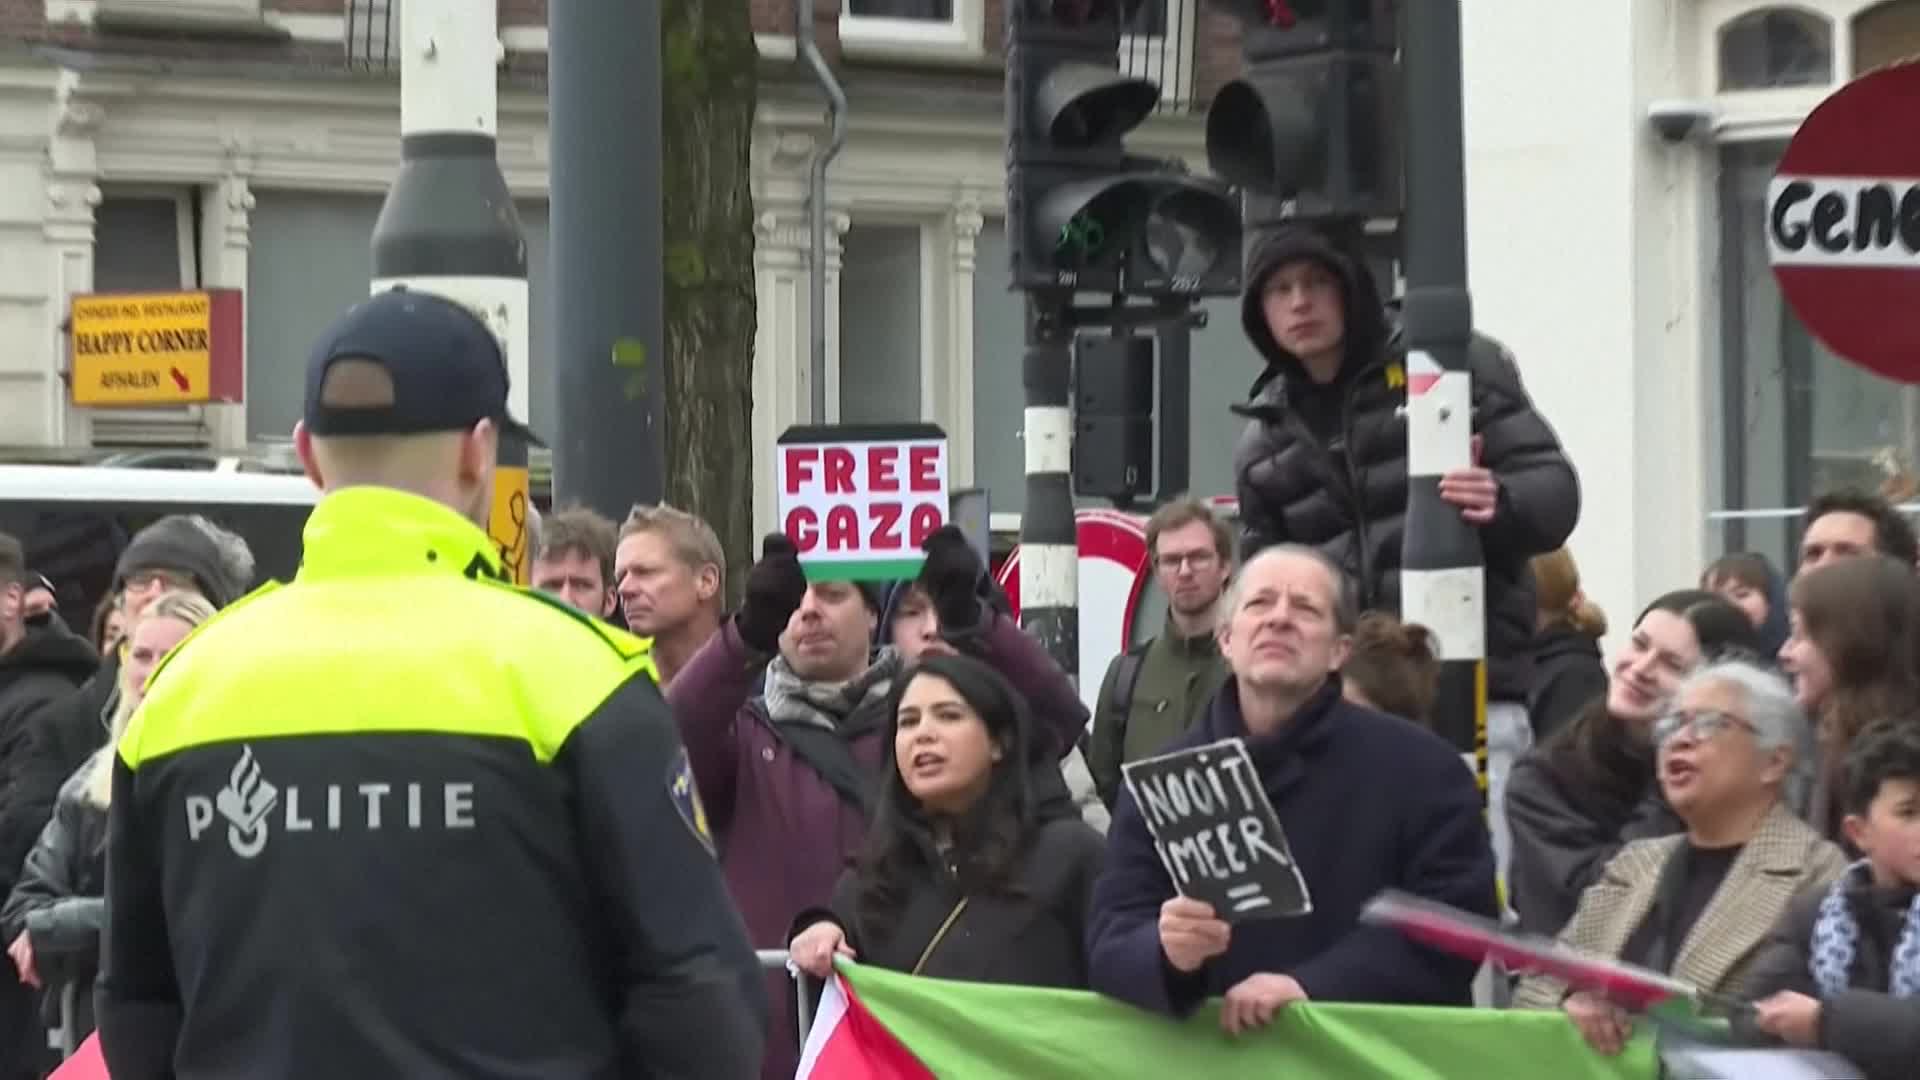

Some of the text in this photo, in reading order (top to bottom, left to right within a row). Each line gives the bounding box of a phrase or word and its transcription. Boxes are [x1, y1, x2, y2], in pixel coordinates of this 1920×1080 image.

[77, 327, 208, 354] HAPPY CORNER
[785, 446, 941, 494] FREE
[785, 502, 942, 553] GAZA
[186, 774, 475, 858] POLITIE
[1168, 816, 1289, 883] MEER
